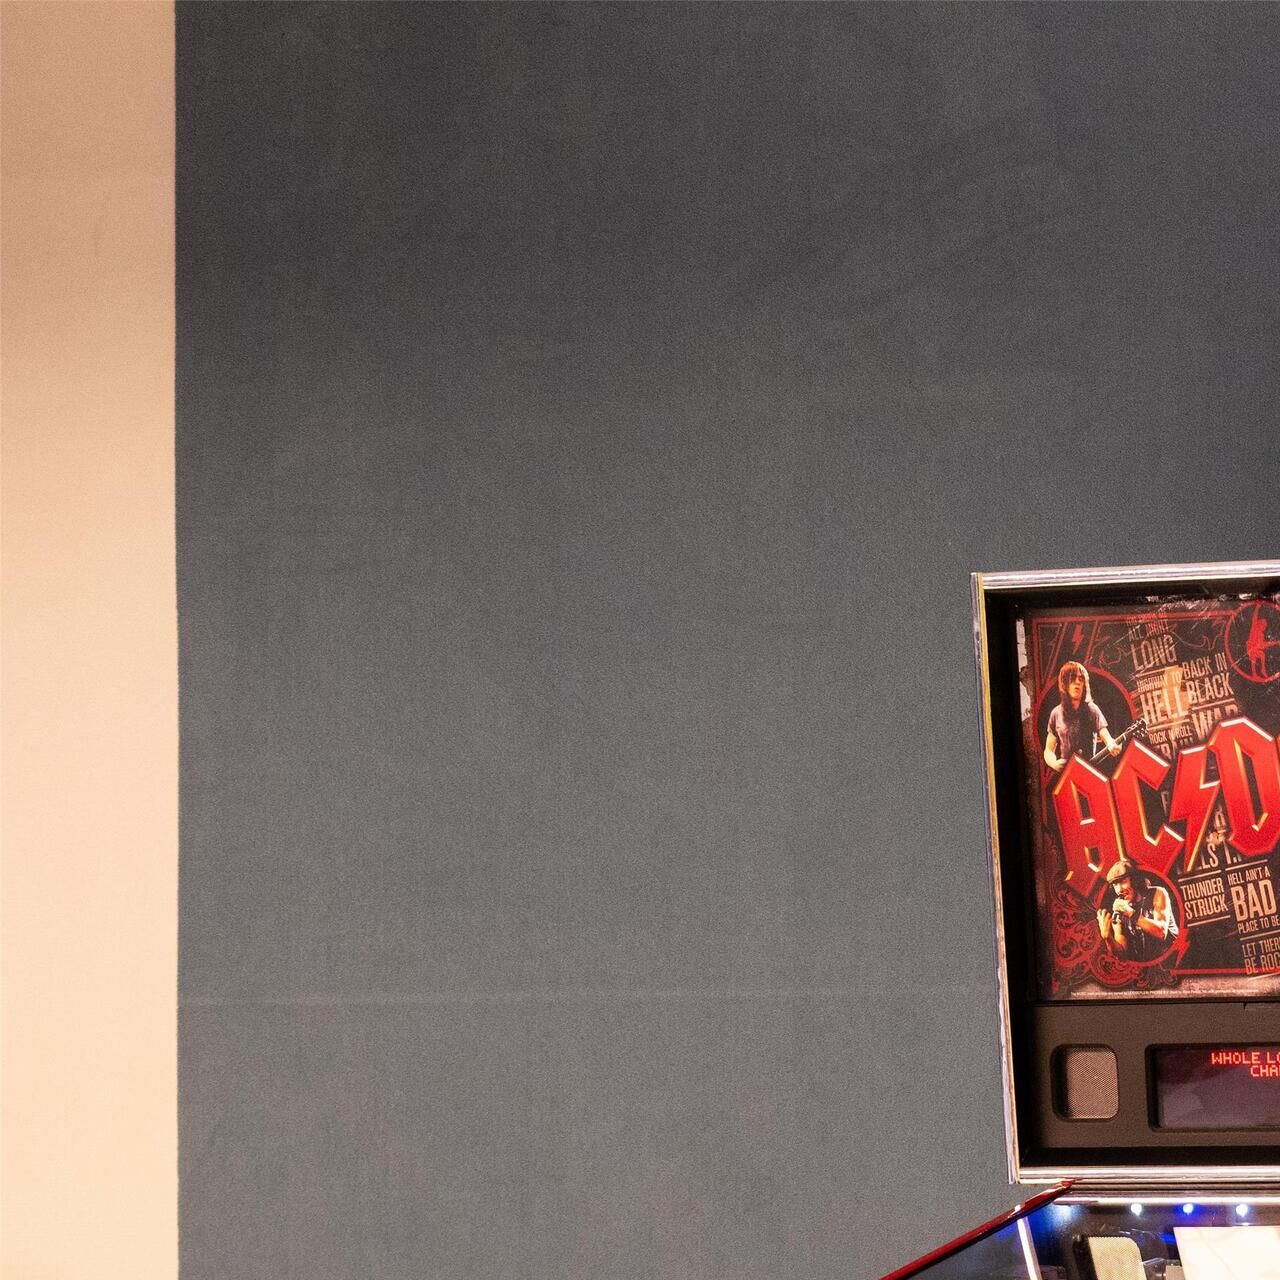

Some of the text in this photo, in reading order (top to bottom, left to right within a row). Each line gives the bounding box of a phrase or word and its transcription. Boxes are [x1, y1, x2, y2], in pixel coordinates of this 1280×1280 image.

[1130, 634, 1177, 671] LONG
[1182, 652, 1228, 680] BACK IN
[1185, 672, 1235, 704] BLACK
[1139, 686, 1189, 727] HELL
[1149, 731, 1168, 745] ROCK
[1227, 865, 1272, 886] HELL AIN'T A
[1180, 877, 1225, 901] THUNDER
[1231, 880, 1278, 921] BAD
[1184, 894, 1229, 920] STRUCK
[1238, 915, 1280, 935] PLACE TO BE
[1242, 942, 1258, 958] LET
[1244, 957, 1260, 975] BE
[1211, 1051, 1261, 1065] WHOLE
